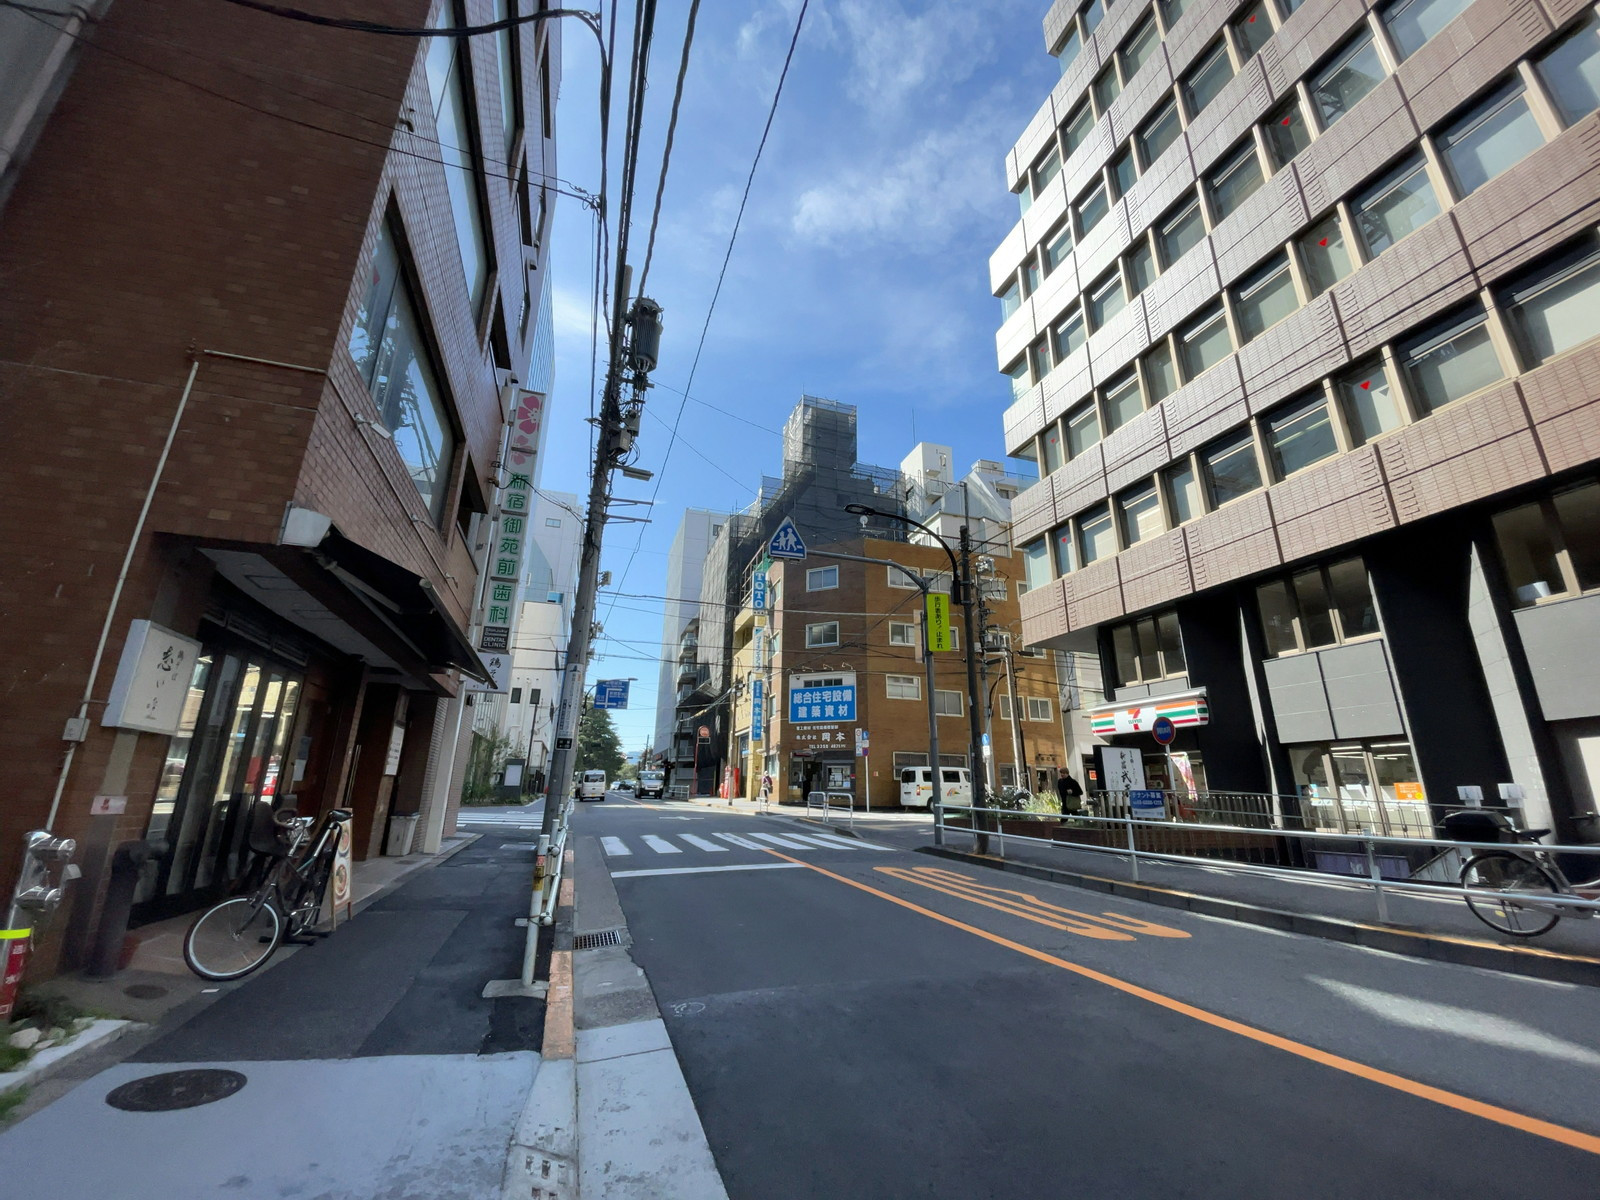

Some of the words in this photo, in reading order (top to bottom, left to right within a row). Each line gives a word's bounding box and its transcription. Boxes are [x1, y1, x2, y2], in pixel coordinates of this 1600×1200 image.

[488, 473, 529, 624] 新宿御苑前歯科
[754, 573, 764, 609] TOTO
[793, 689, 853, 704] 総合住宅設備
[798, 704, 848, 718] 建築資材
